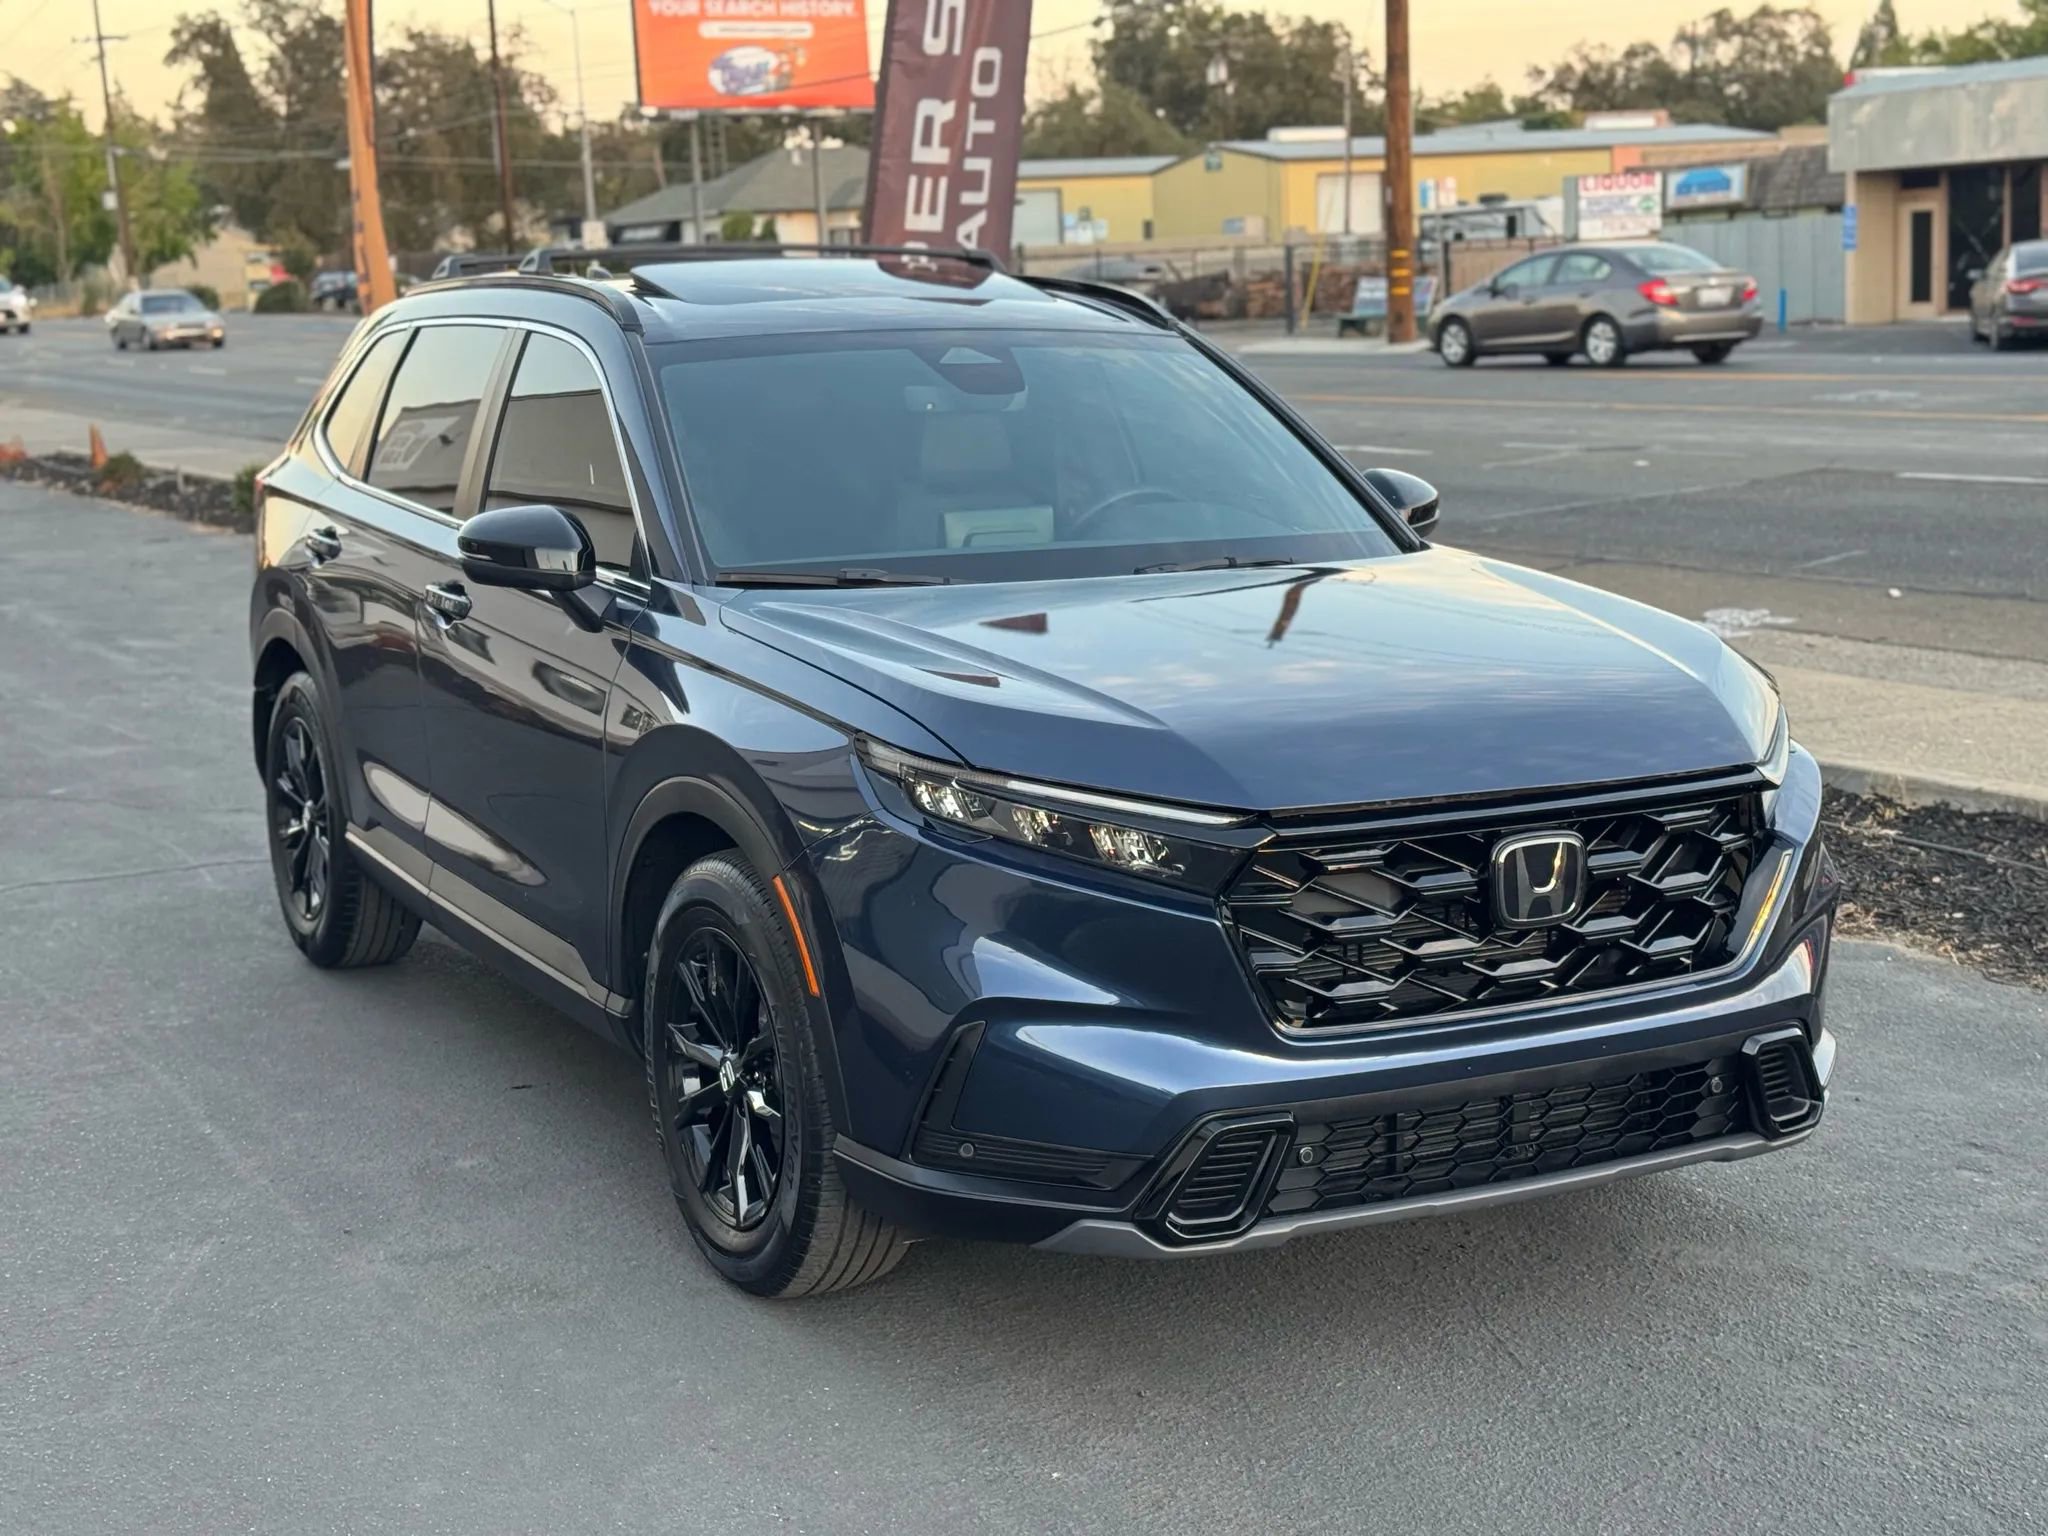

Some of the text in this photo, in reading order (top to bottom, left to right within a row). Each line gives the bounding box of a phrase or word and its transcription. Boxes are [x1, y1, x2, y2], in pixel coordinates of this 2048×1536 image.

[649, 0, 700, 16] YOUR
[704, 0, 777, 16] SEARCH
[956, 47, 1002, 249] AUTO
[1580, 172, 1655, 192] LIQUOR
